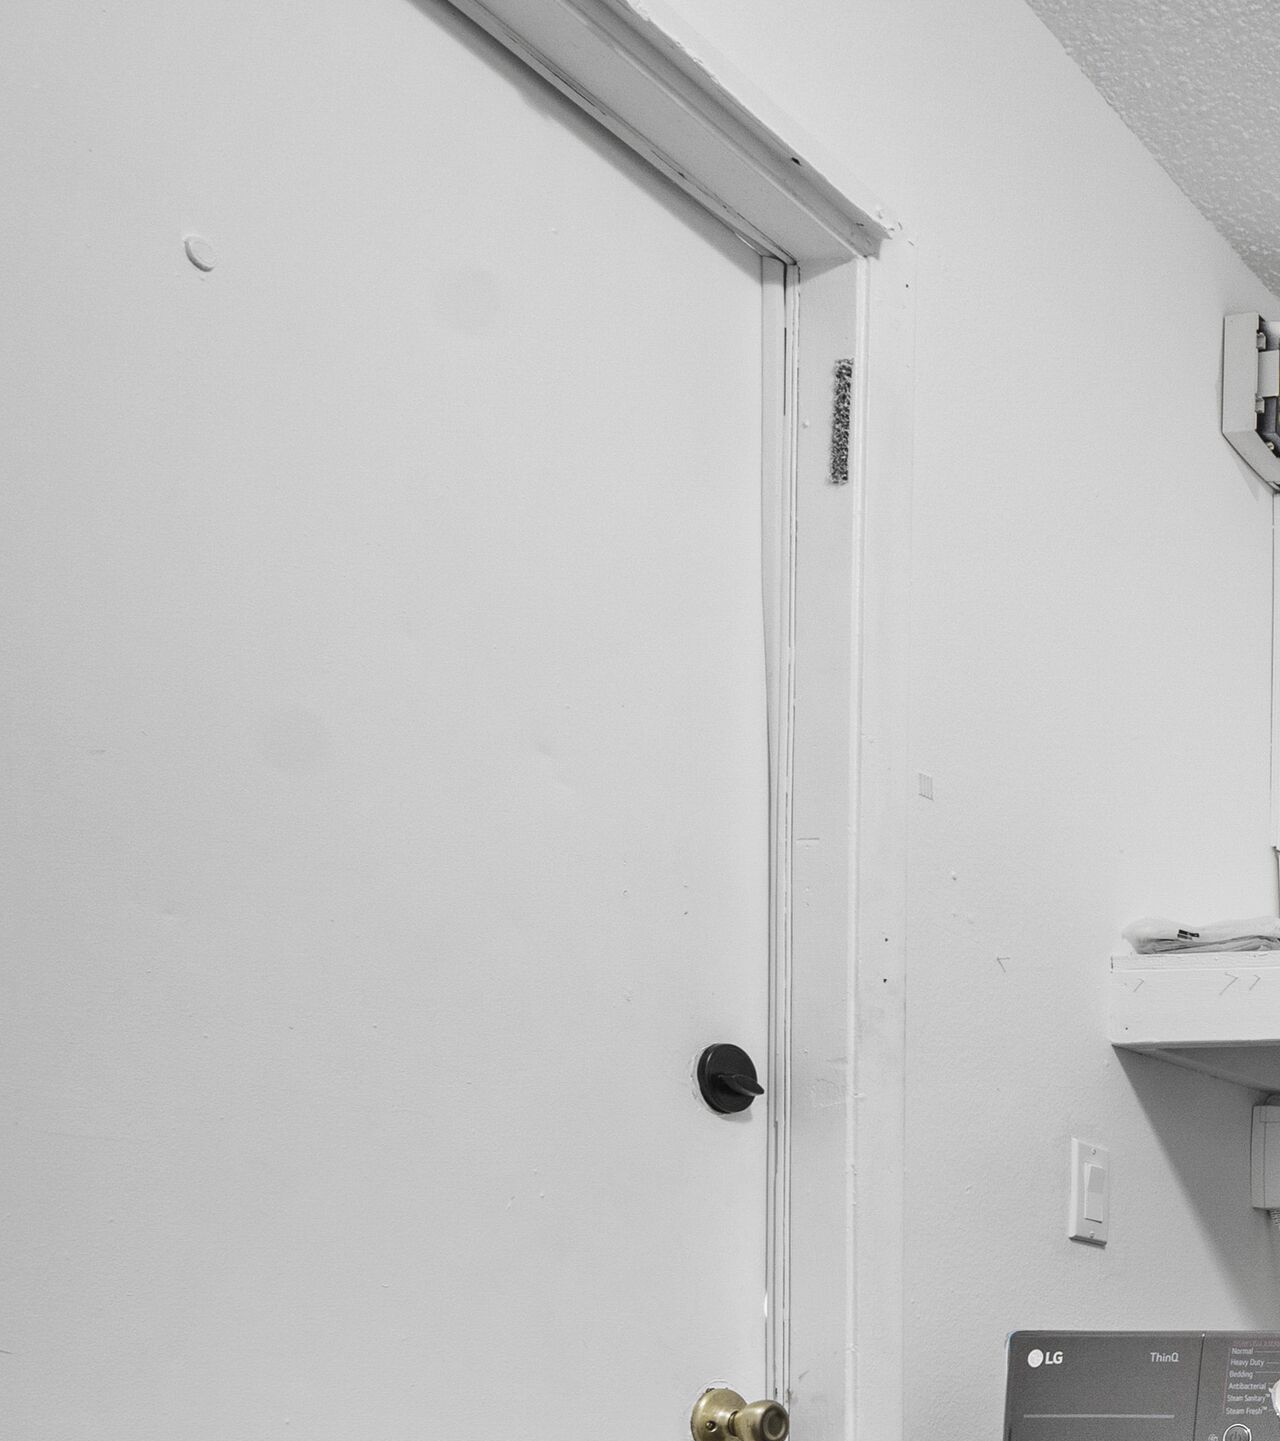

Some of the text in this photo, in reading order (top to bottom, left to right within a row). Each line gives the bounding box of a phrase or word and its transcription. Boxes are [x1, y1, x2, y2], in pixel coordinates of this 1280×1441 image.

[1232, 1347, 1254, 1355] Normal
[1150, 1352, 1179, 1362] ThinQ
[1230, 1359, 1265, 1367] Heavy Duty
[1229, 1370, 1253, 1379] Bedding
[1228, 1382, 1267, 1390] Antibacterial
[1227, 1394, 1244, 1402] Steam
[1225, 1407, 1245, 1415] Steam
